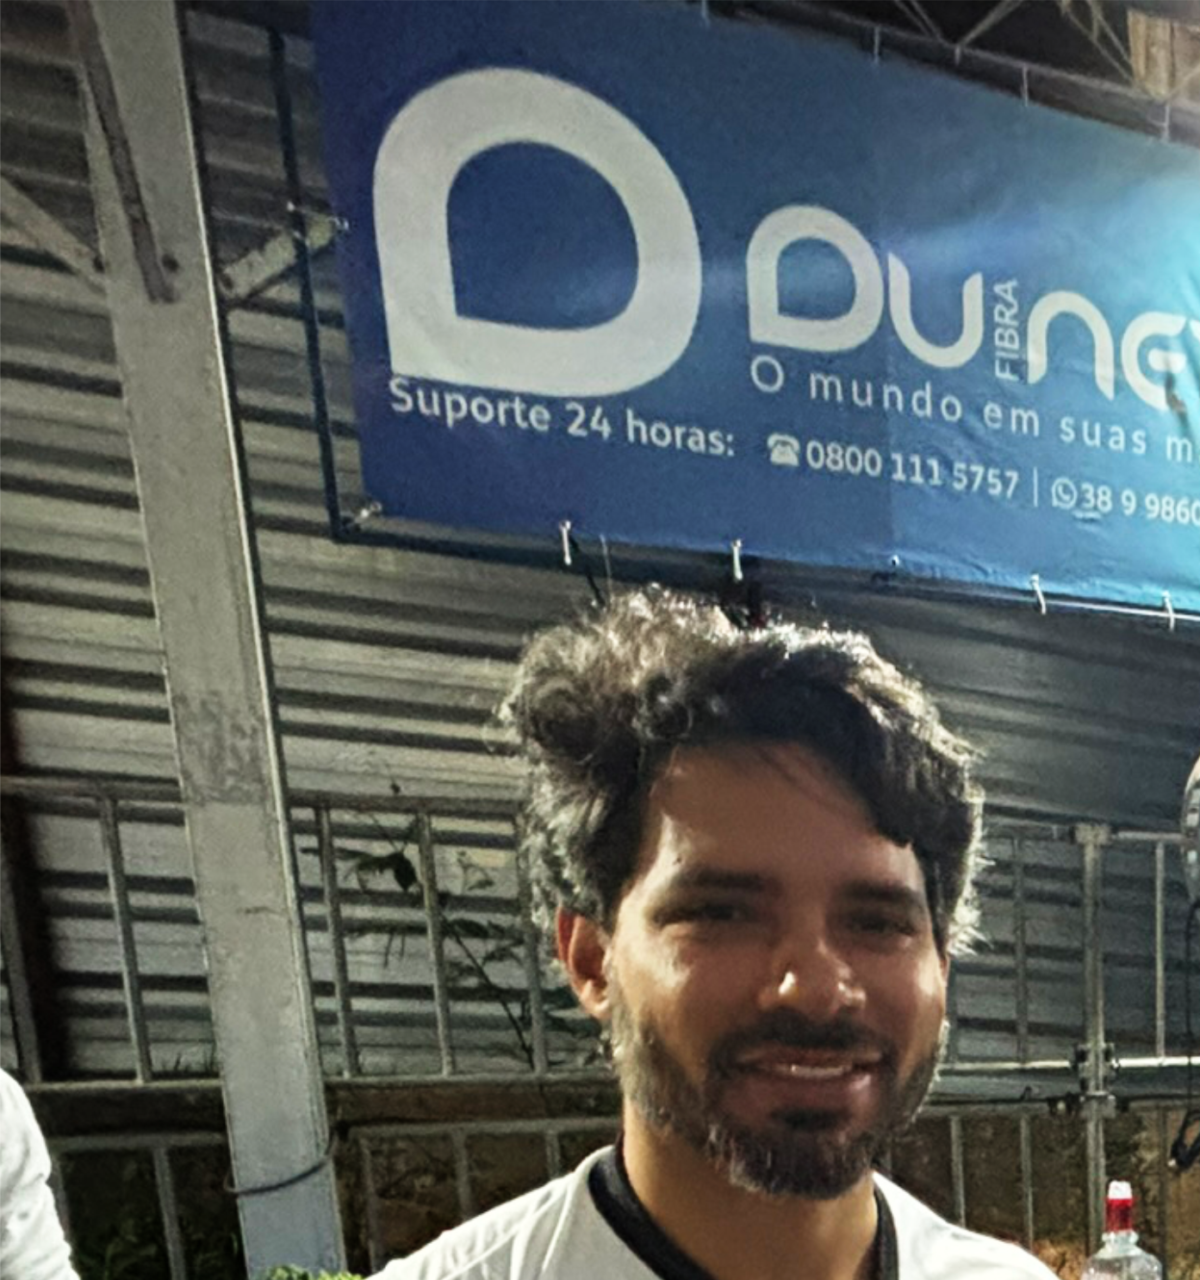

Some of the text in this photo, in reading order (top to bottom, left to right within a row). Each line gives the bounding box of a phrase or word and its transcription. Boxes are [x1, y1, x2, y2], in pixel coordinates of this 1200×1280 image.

[993, 278, 1019, 381] FIBRA
[388, 376, 551, 431] Suporte
[564, 401, 612, 440] 24
[626, 407, 735, 456] horas:
[806, 440, 882, 477] 0800
[890, 452, 943, 486] 111
[952, 463, 1019, 499] 5757
[1080, 482, 1113, 513] 38
[1121, 490, 1137, 516] 9
[751, 355, 784, 392] O
[809, 372, 962, 422] mundo
[984, 401, 1040, 436] em
[1060, 416, 1147, 455] suas
